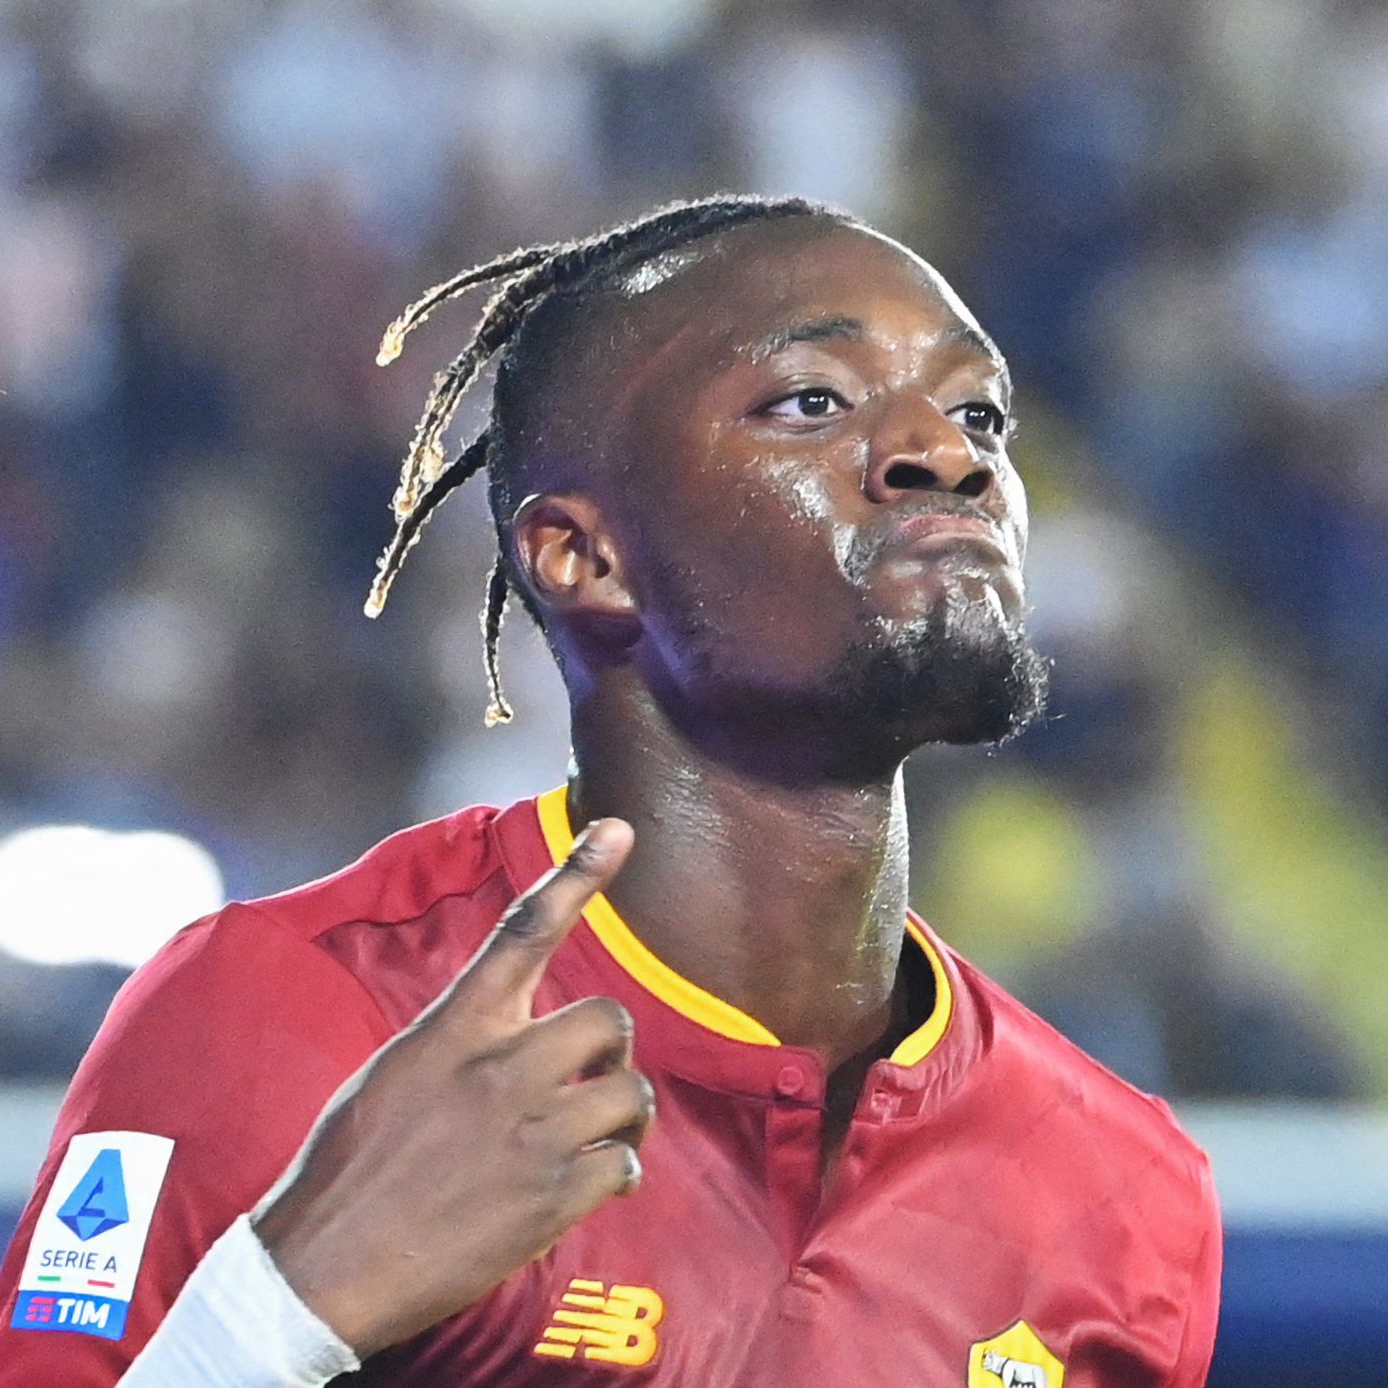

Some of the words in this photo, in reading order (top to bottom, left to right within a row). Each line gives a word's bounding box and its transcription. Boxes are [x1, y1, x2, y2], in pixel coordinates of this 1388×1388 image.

[41, 1251, 98, 1270] SERIE
[104, 1257, 117, 1272] A
[57, 1298, 110, 1328] TIM
